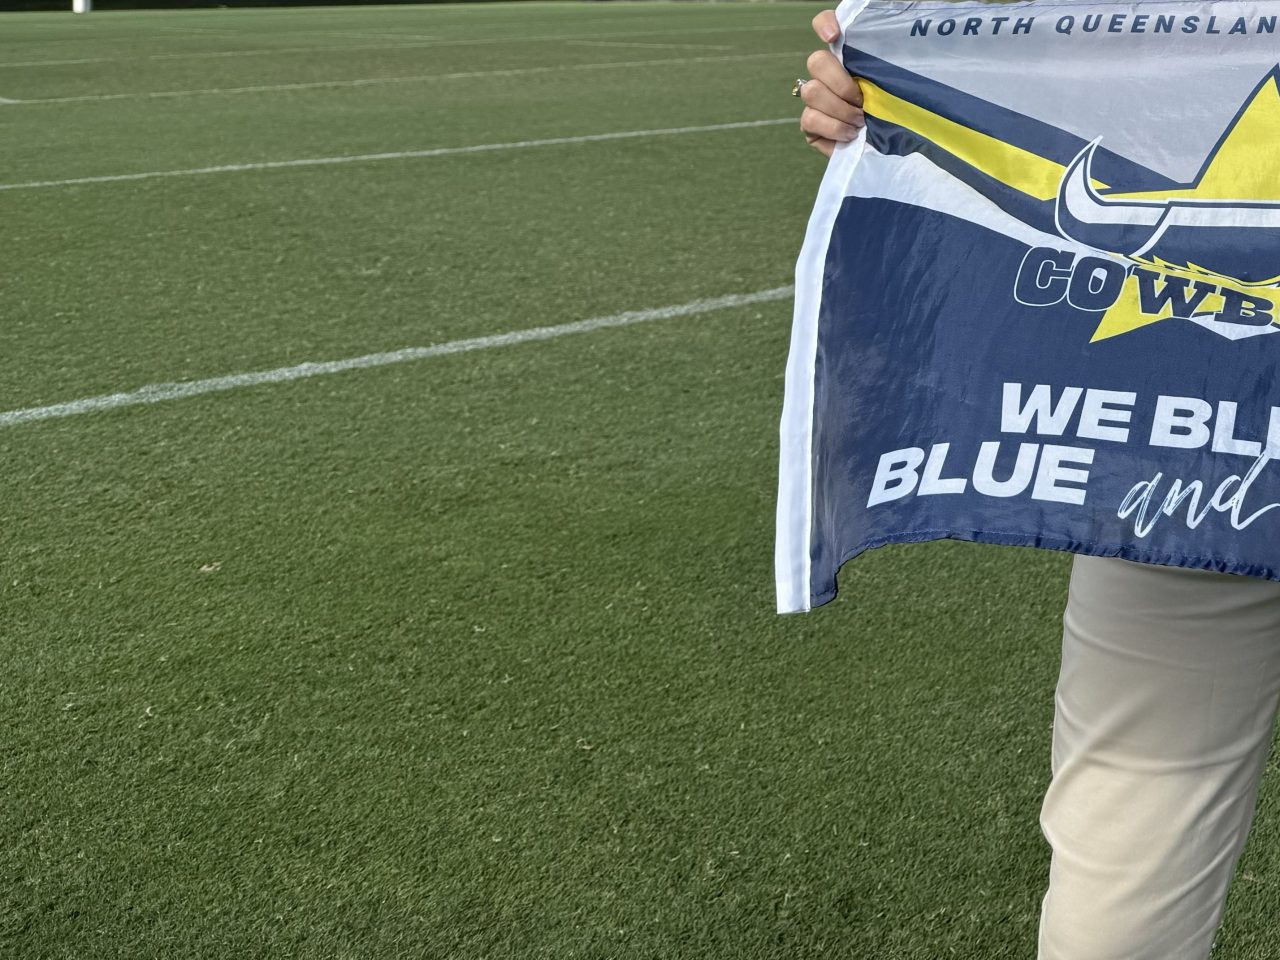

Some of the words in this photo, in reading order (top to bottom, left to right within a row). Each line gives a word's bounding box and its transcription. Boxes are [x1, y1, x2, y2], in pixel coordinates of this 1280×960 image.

[910, 16, 1035, 37] NORTH
[1000, 382, 1137, 443] WE
[866, 441, 1095, 508] BLUE
